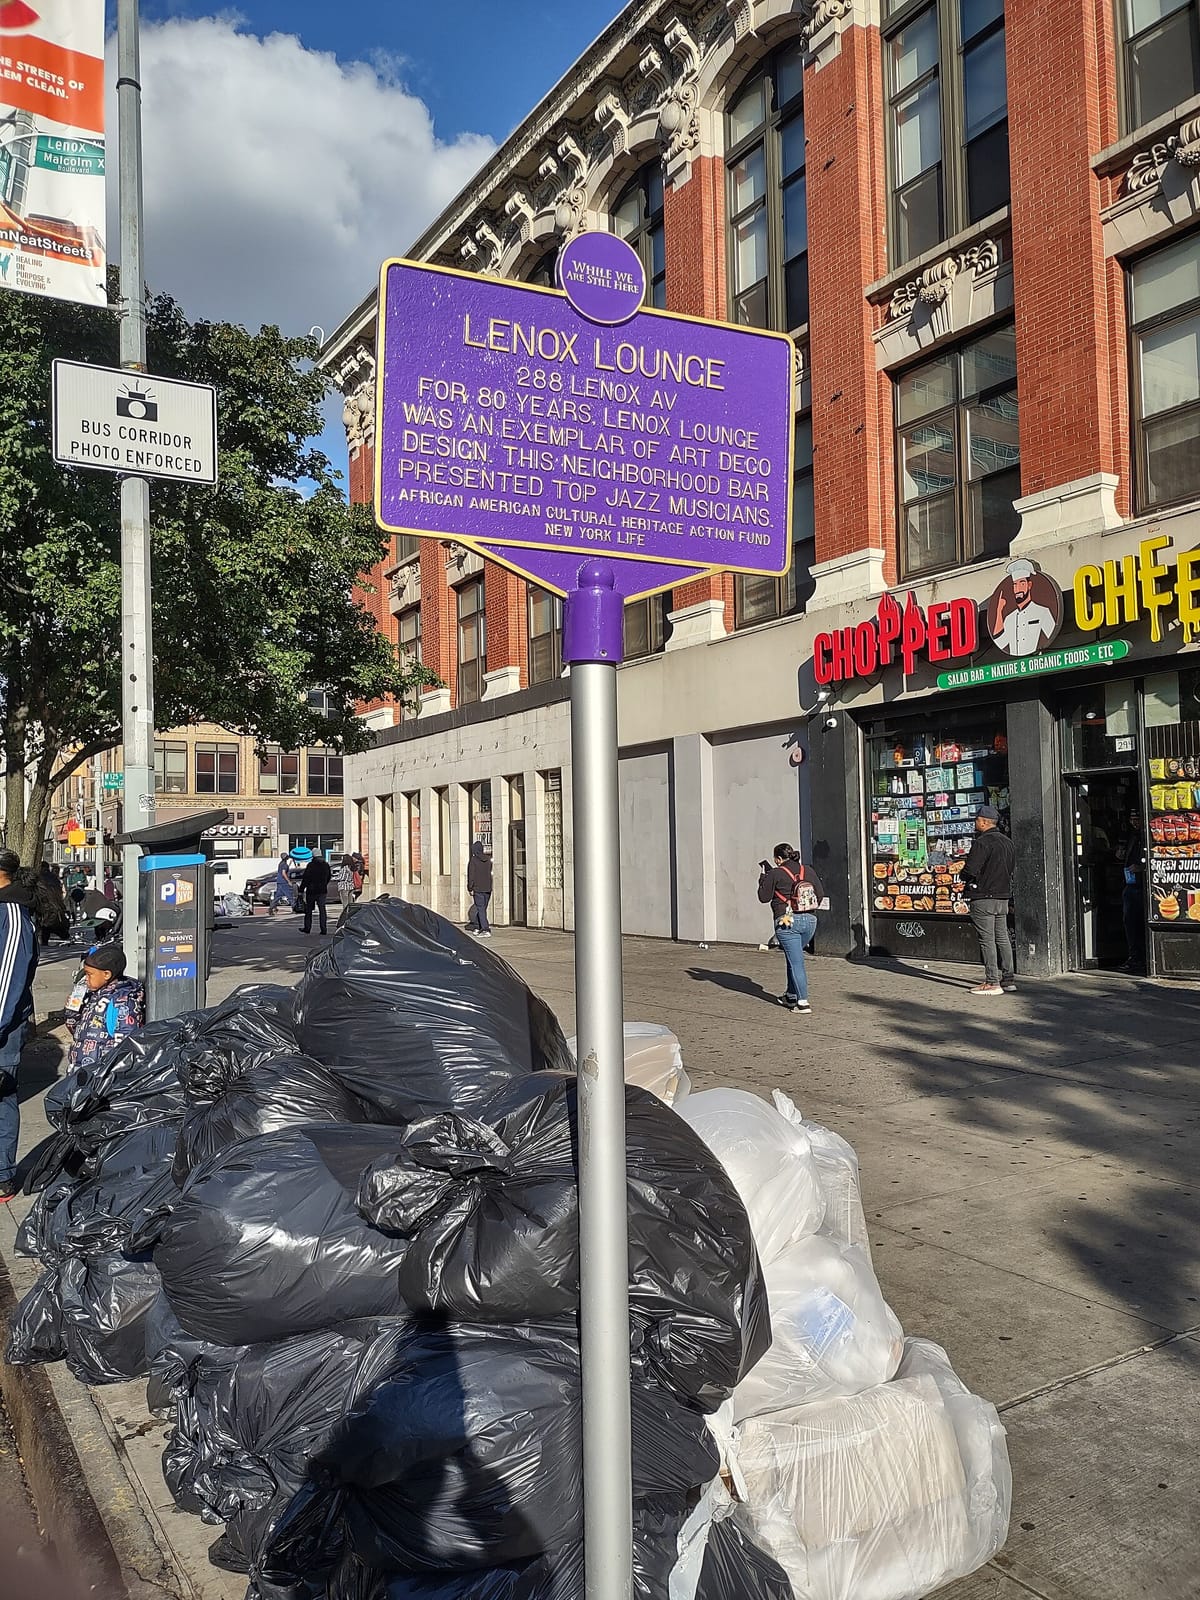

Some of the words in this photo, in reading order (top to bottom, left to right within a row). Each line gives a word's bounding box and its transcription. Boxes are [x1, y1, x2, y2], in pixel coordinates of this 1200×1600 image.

[16, 61, 64, 86] STREETS
[68, 79, 85, 91] OF
[26, 77, 69, 99] CLEAN.
[47, 137, 86, 152] Lenox
[44, 152, 92, 167] Malcolm
[98, 158, 104, 168] X
[58, 164, 90, 174] Boulevard
[16, 255, 42, 267] HEALING
[16, 262, 25, 270] ON
[572, 260, 612, 280] WHILE
[615, 270, 633, 284] WE
[16, 270, 45, 282] PURPOSE
[16, 278, 46, 290] EVOLVING
[463, 314, 580, 366] LENOX
[594, 338, 726, 391] LOUNGE
[516, 366, 563, 392] 288
[571, 374, 640, 406] LENOX
[650, 390, 678, 411] AV
[418, 377, 468, 404] FOR
[478, 387, 506, 410] 80
[516, 392, 597, 426] YEARS,
[604, 407, 671, 437] LENOX
[680, 420, 760, 450] LOUNGE
[81, 420, 111, 437] BUS
[118, 426, 192, 450] CORRIDOR
[402, 402, 453, 430] WAS
[463, 413, 494, 436] AN
[502, 418, 626, 456] EXEMPLAR
[634, 440, 660, 460] OF
[669, 445, 711, 468] ART
[718, 452, 772, 477] DECO
[71, 441, 120, 461] PHOTO
[126, 450, 202, 473] ENFORCED
[403, 429, 493, 463] DESIGN.
[502, 445, 554, 472] THIS
[562, 454, 721, 496] NEIGHBORHOOD
[728, 478, 770, 502] BAR
[399, 458, 544, 497] PRESENTED
[552, 479, 597, 504] TOP
[606, 488, 662, 514] JAZZ
[670, 495, 775, 528] MUSICIANS.
[399, 488, 464, 508] AFRICAN
[469, 497, 541, 518] AMERICAN
[546, 506, 616, 528] CULTURAL
[621, 516, 684, 536] HERITAGE
[690, 524, 735, 542] ACTION
[738, 531, 771, 546] FUND
[544, 522, 574, 538] NEW
[579, 526, 612, 542] YORK
[617, 531, 646, 547] LIFE
[813, 591, 978, 685] CHOPPED
[947, 674, 968, 686] SALAD
[970, 670, 984, 682] BAR
[991, 663, 1018, 678] NATURE
[1020, 661, 1026, 672] &
[1028, 654, 1062, 672] ORGANIC
[1064, 650, 1090, 664] FOODS
[1098, 644, 1114, 659] ETC
[220, 825, 268, 836] COFFEE
[160, 883, 175, 902] P
[900, 886, 936, 894] BREAKFAST
[166, 934, 194, 942] ParkNYC
[160, 968, 188, 978] 110147
